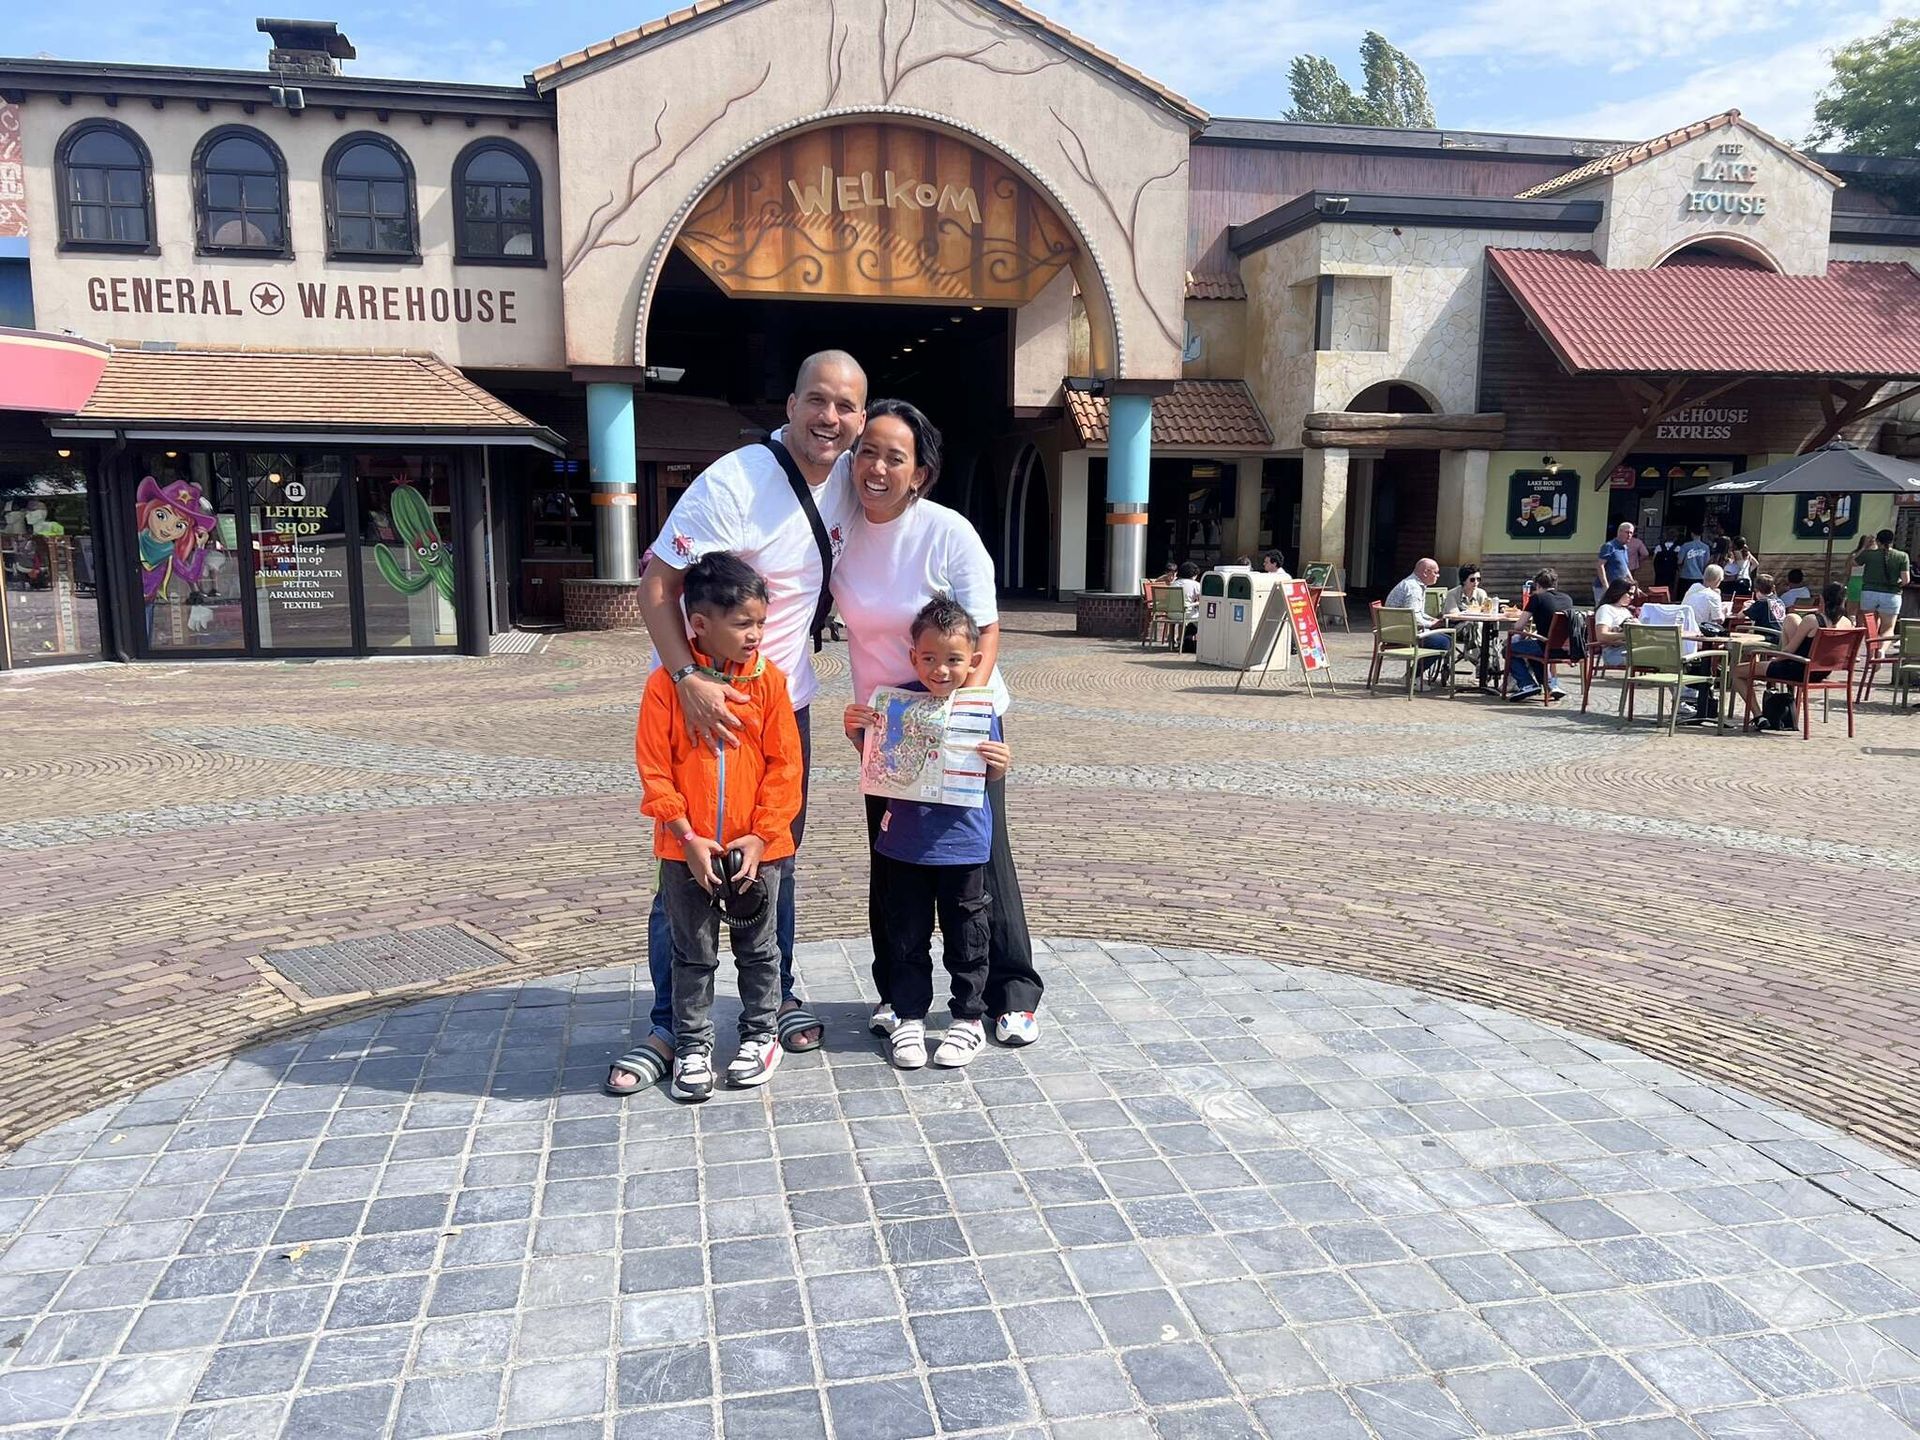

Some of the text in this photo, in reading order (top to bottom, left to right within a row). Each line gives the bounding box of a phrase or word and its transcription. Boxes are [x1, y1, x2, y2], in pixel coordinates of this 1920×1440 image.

[1719, 143, 1745, 155] THE
[1699, 161, 1758, 184] LAKE
[787, 164, 982, 224] WELKOM
[1686, 190, 1768, 216] HOUSE
[87, 276, 517, 324] GENERAL WAREHOUSE
[1656, 425, 1732, 439] EXPRESS
[265, 505, 328, 518] LETTER
[275, 522, 320, 535] SHOP
[272, 544, 326, 555] Zet hier je
[277, 556, 322, 566] naam op
[258, 569, 342, 578] NUMMERPLATEN
[282, 580, 320, 588] PETTEN
[269, 590, 334, 599] ARMBANDEN
[282, 601, 323, 610] TEXTIEL
